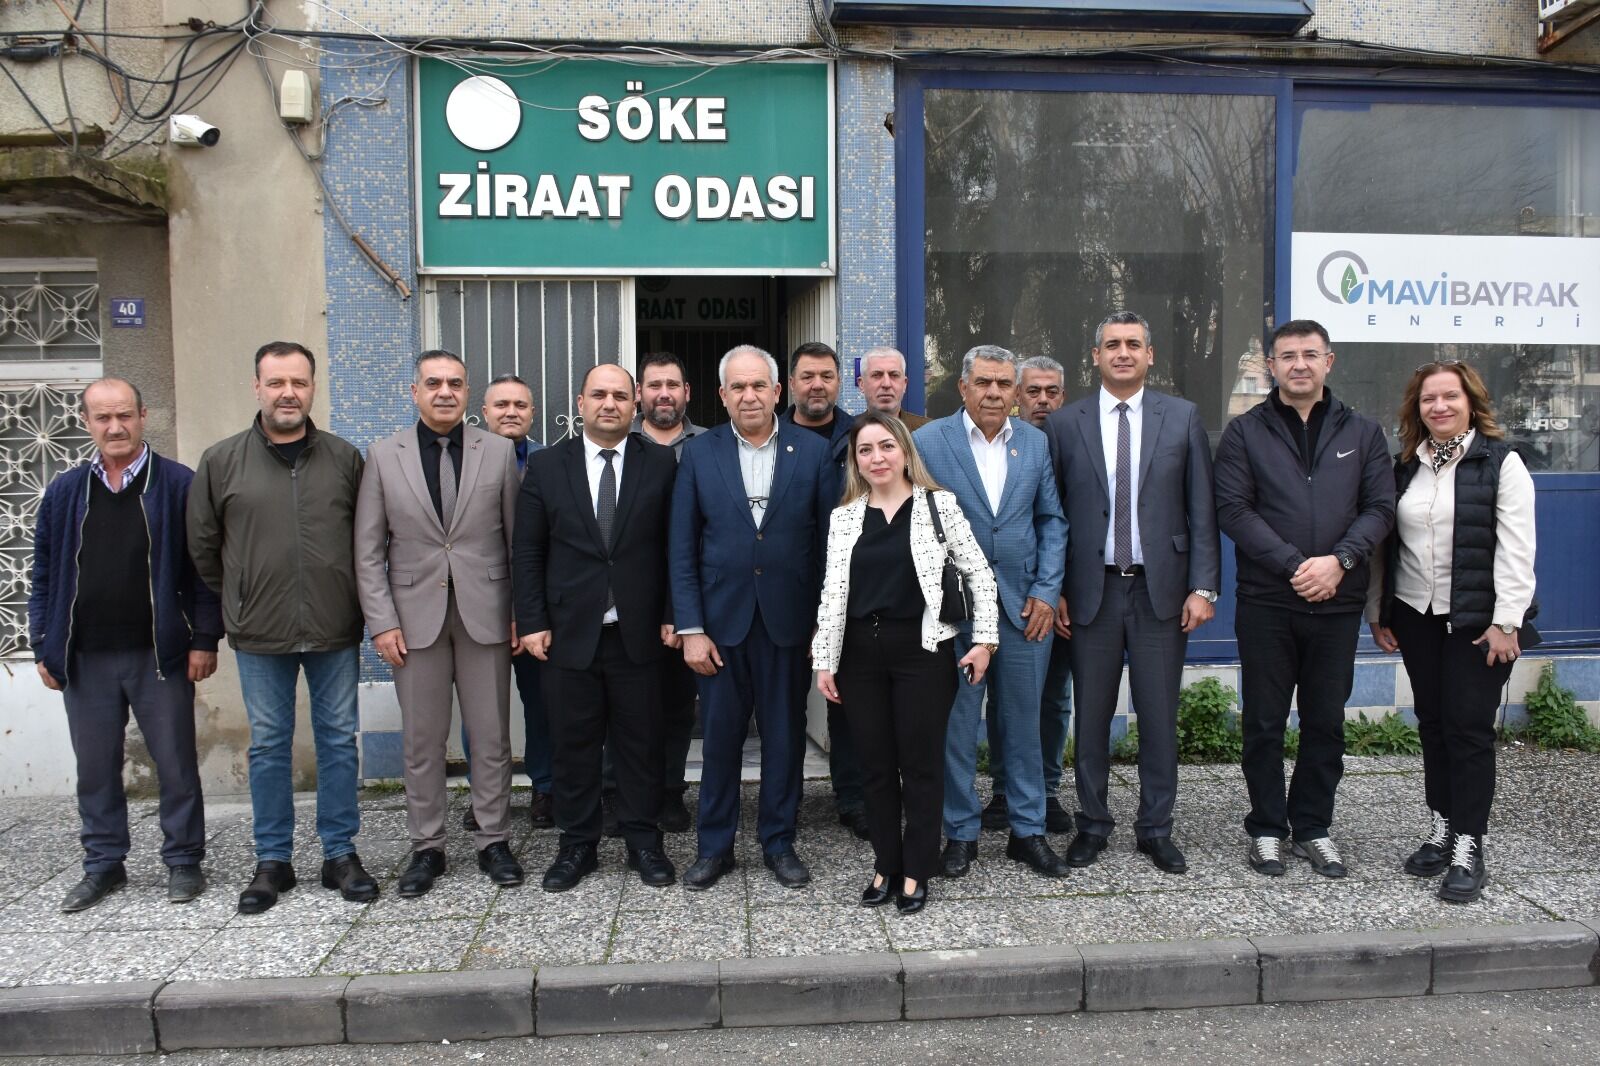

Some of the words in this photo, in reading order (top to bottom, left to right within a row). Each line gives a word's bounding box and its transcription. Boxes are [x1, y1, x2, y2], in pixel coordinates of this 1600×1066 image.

[577, 80, 728, 142] SÖKE
[438, 160, 632, 218] ZİRAAT
[654, 174, 815, 220] ODASI
[119, 302, 136, 315] 40
[637, 297, 687, 320] RAAT
[697, 297, 756, 320] ODASI
[1367, 313, 1580, 328] ENERJİ
